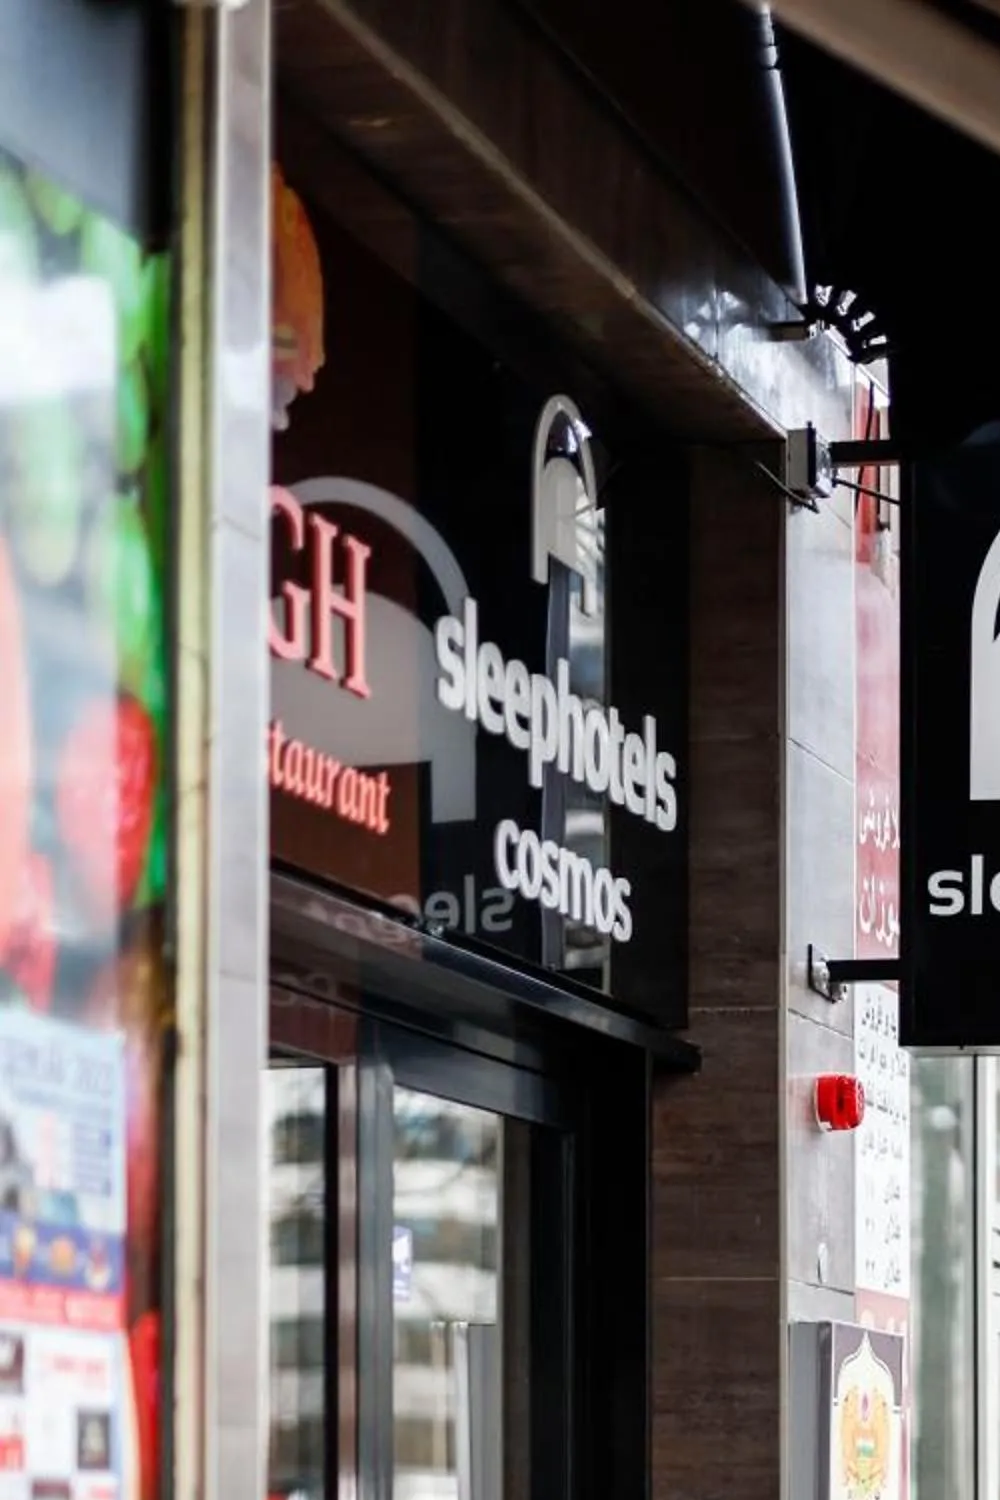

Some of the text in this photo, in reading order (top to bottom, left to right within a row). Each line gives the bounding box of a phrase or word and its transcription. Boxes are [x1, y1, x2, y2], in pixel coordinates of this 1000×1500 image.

[267, 718, 390, 834] taurant
[435, 597, 677, 832] sleephotels
[495, 818, 632, 943] cosmos
